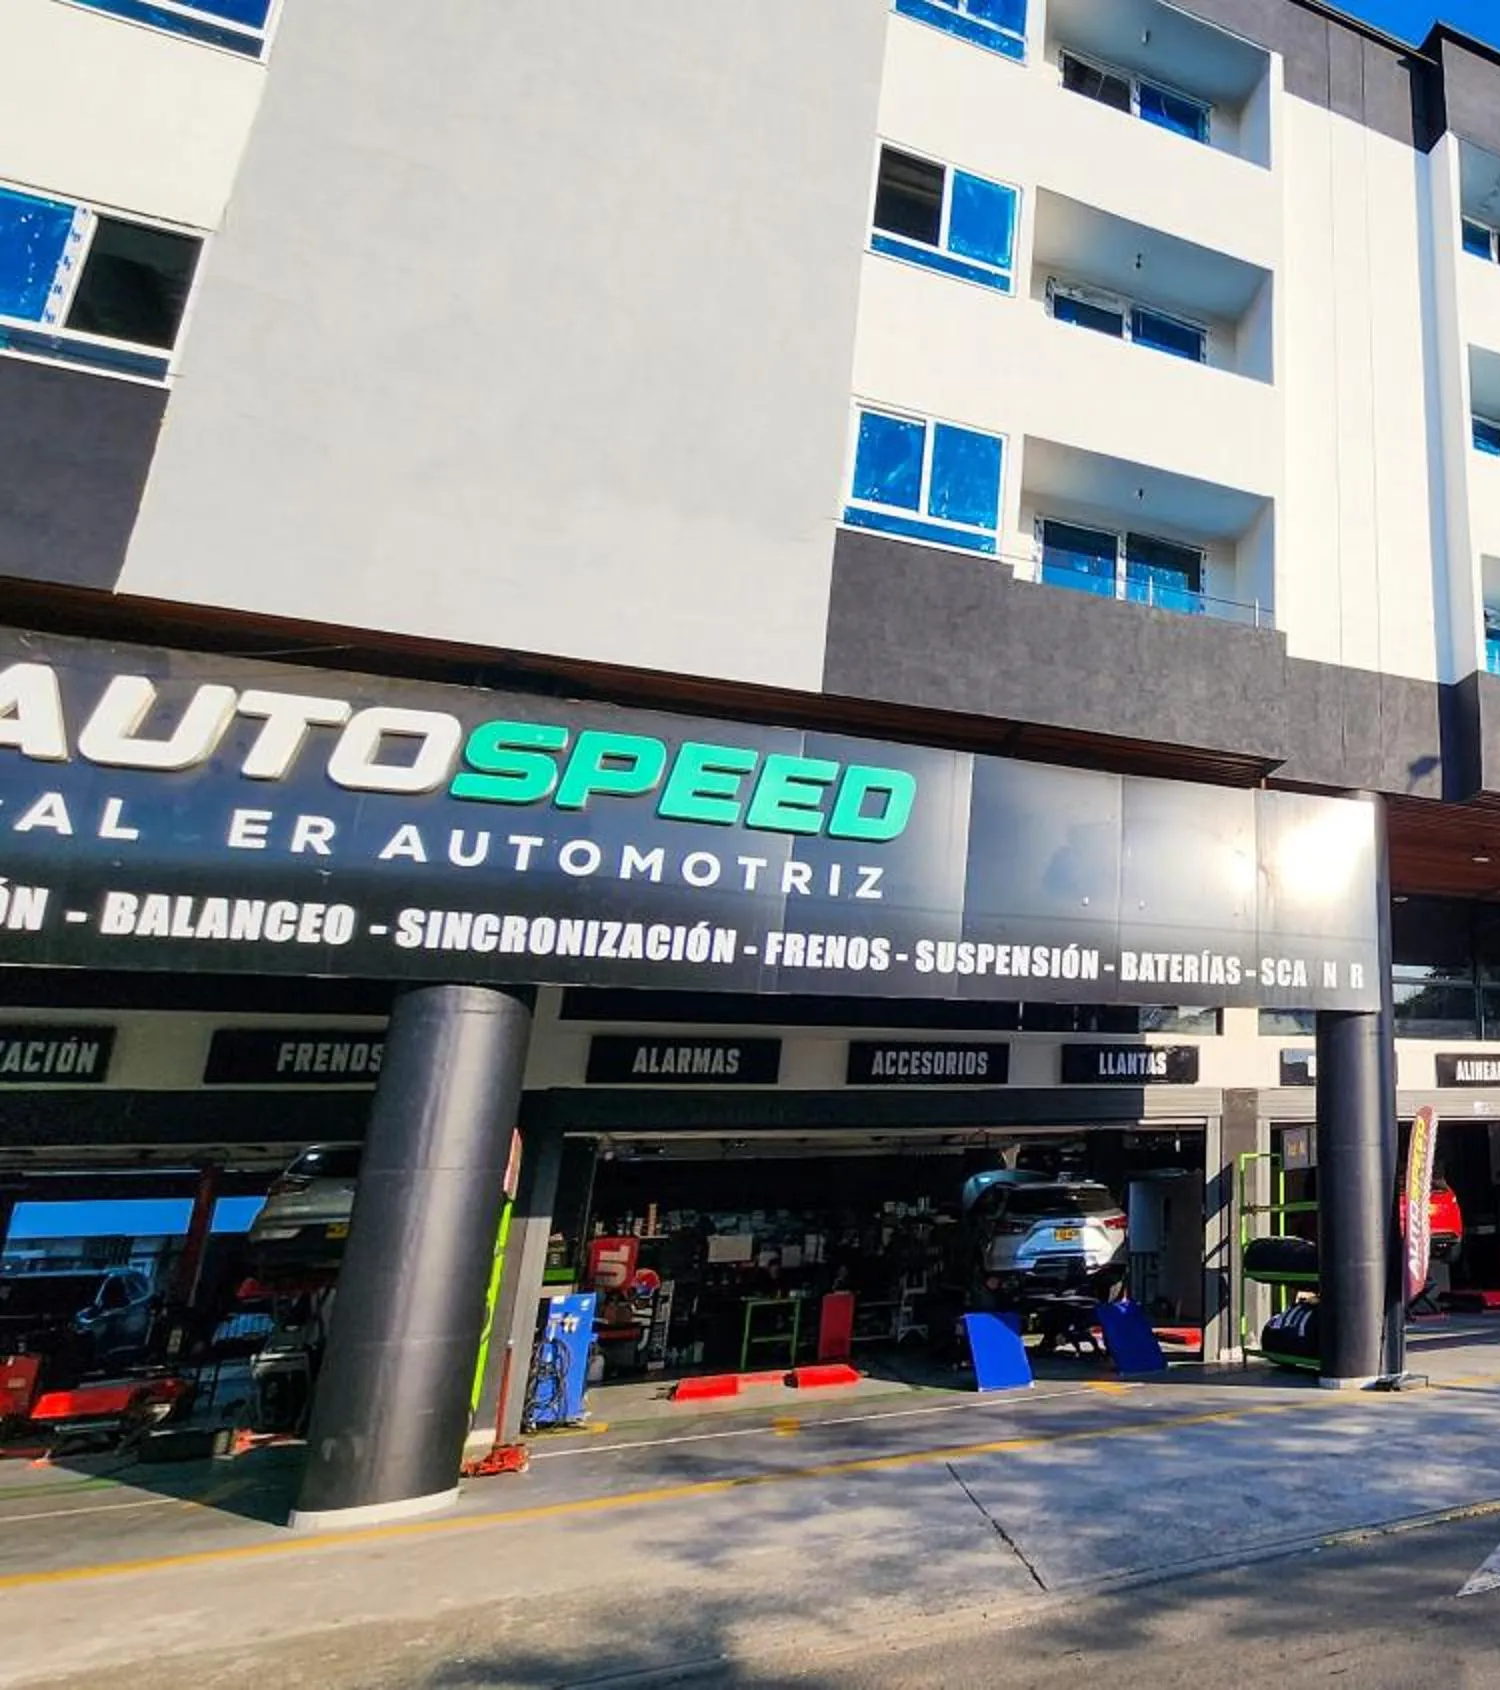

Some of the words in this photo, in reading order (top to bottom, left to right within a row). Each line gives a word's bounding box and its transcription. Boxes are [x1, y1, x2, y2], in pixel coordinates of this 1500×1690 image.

[379, 825, 884, 899] AUTOMOTRIZ
[100, 891, 356, 945] BALANCEO
[394, 907, 737, 965] SINCRONIZACIÓN
[765, 932, 891, 972] FRENOS
[915, 940, 1099, 980] SUSPENSIÓN
[1121, 949, 1243, 985] BATERÍAS
[0, 1036, 99, 1074] ACIÓN
[276, 1041, 385, 1073] FRENOS
[632, 1046, 741, 1075] ALARMAS
[872, 1050, 989, 1076] ACCESORIOS
[1098, 1050, 1168, 1076] LLANTAS
